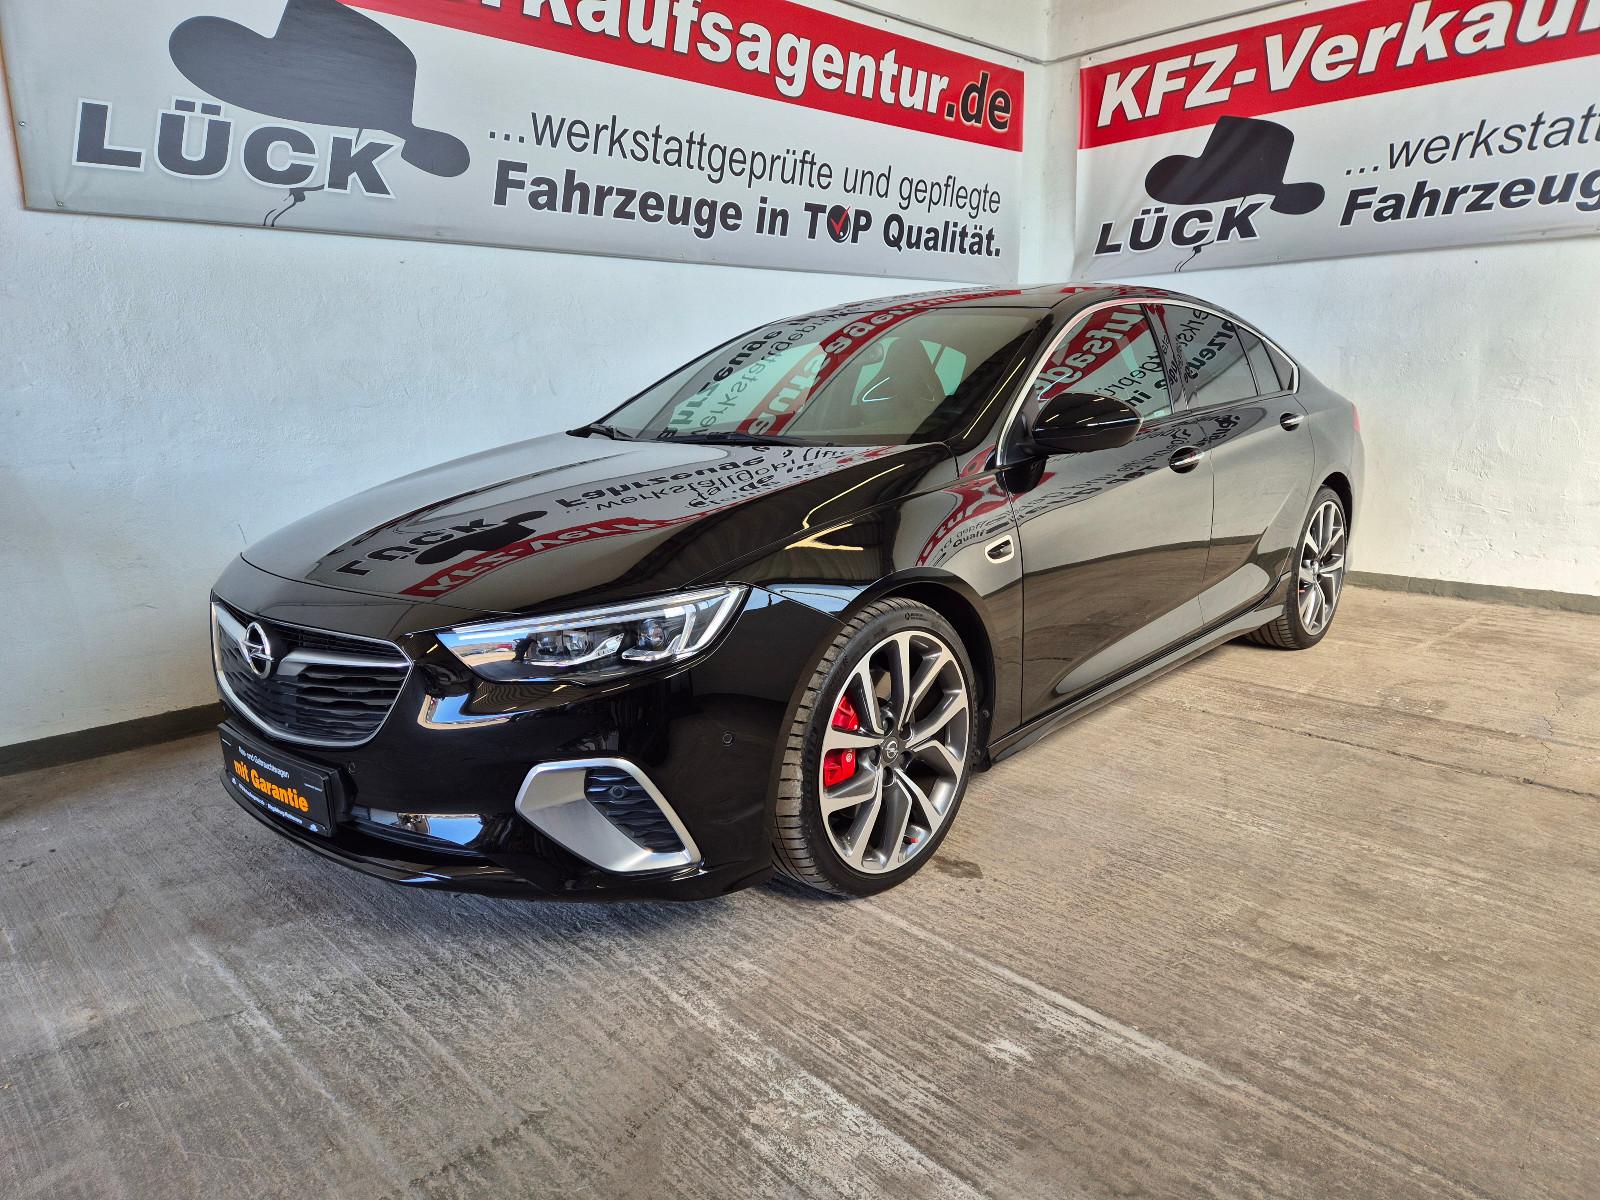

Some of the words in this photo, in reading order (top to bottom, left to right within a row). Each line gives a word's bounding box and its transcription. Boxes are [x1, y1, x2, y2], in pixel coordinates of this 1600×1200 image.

[1097, 0, 1600, 127] KFZ-Verkau
[74, 97, 396, 199] LÜCK
[1345, 103, 1600, 176] ...werkstat
[492, 159, 743, 240] Fahrzeuge
[755, 196, 790, 238] in
[802, 202, 873, 244] TOP
[882, 213, 1002, 258] Qualität.
[842, 163, 892, 198] und
[898, 173, 1002, 218] gepflegte
[1093, 200, 1270, 256] LÜCK
[233, 759, 249, 783] mit
[250, 768, 309, 812] Garantie
